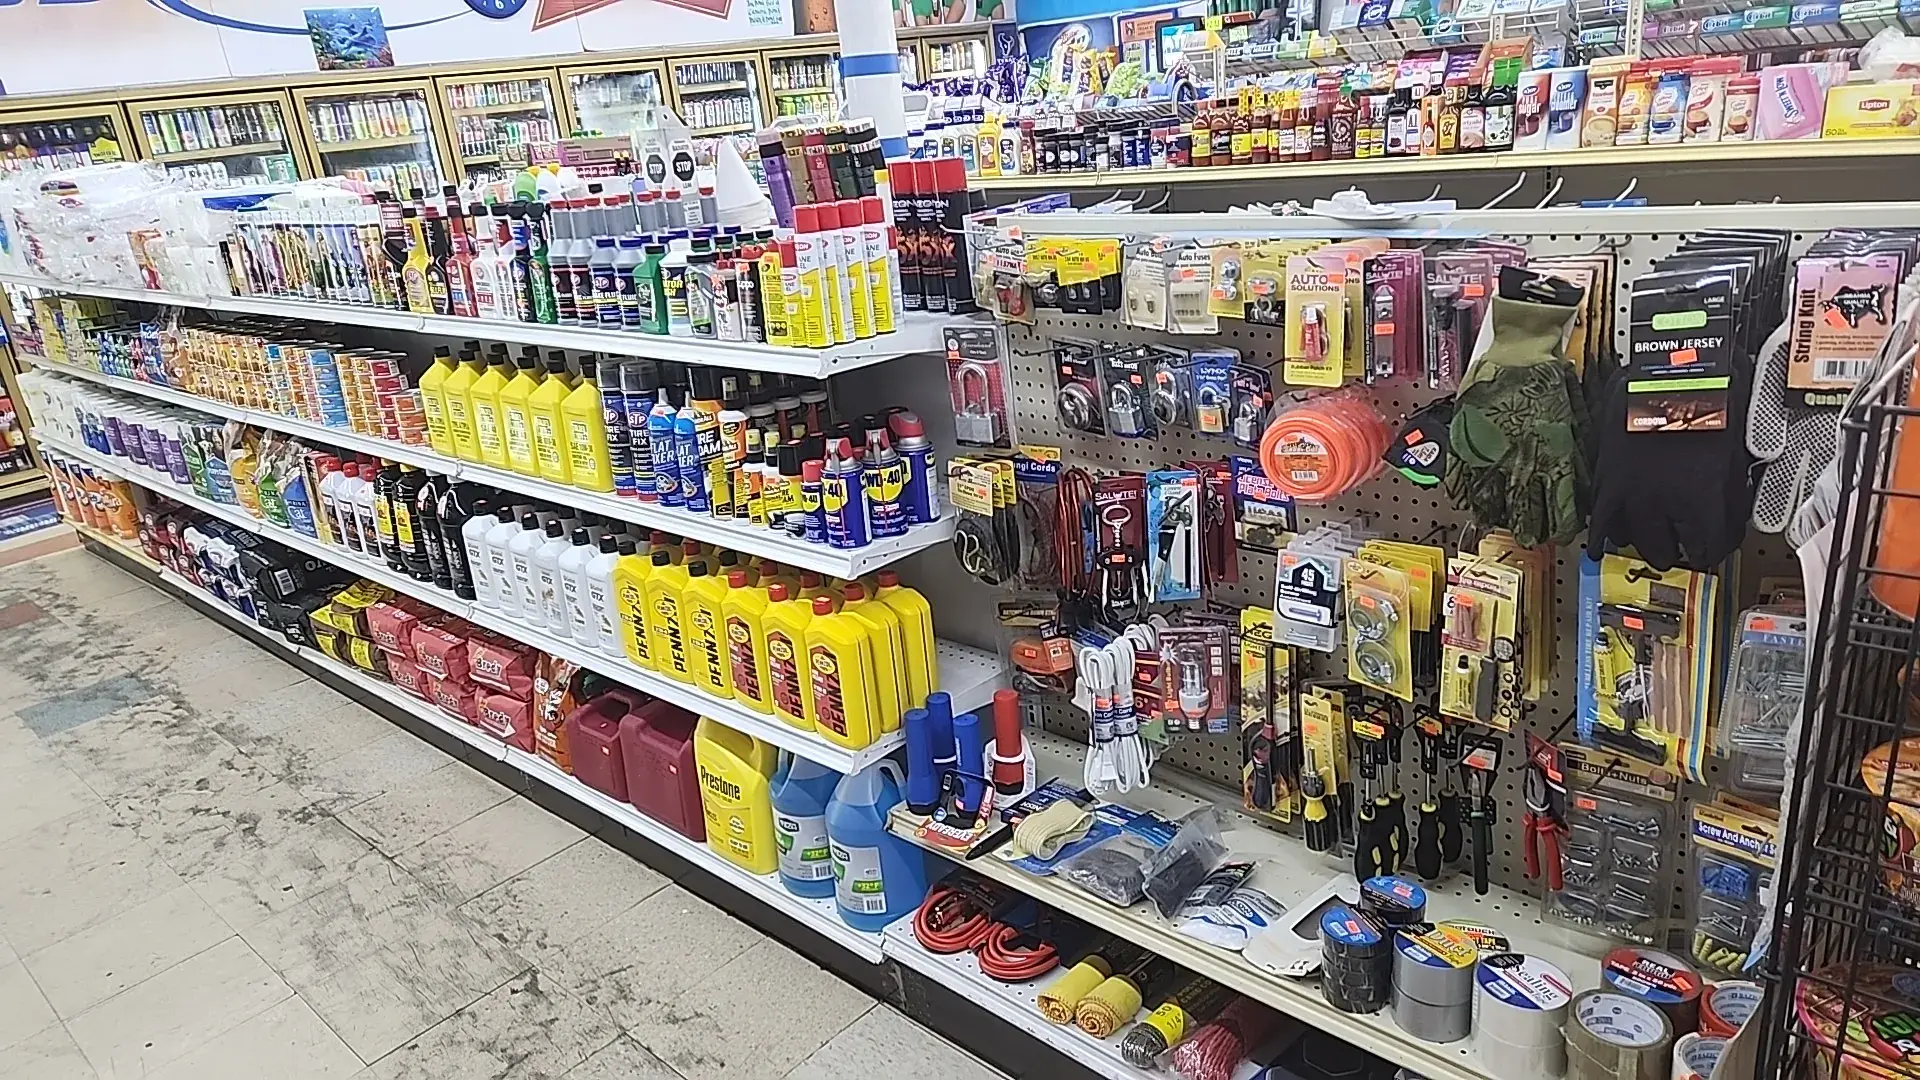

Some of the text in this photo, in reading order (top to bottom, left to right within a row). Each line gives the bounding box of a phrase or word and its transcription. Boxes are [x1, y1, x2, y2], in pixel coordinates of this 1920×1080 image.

[273, 101, 279, 112] 5
[1518, 102, 1542, 117] sugar
[1860, 100, 1888, 110] Lipton
[649, 163, 664, 174] STOP
[676, 160, 692, 173] STOP
[1179, 252, 1211, 260] Auto Fuses
[1291, 274, 1327, 284] AUTO
[1290, 284, 1339, 292] SOLUTIONS
[1703, 296, 1725, 304] LARGE
[1794, 288, 1816, 363] String Knit
[1635, 337, 1723, 353] BROWN JERSEY
[629, 412, 648, 426] STP
[629, 429, 650, 441] TIRE
[632, 437, 648, 446] FIX
[699, 440, 720, 456] OAM
[1030, 462, 1056, 473] Cords
[865, 469, 901, 487] WD-40
[1095, 488, 1137, 501] SALUTE!
[1265, 489, 1290, 502] Bolts
[469, 549, 480, 558] GTX
[492, 556, 504, 566] GTX
[515, 564, 527, 574] GTX
[1301, 568, 1315, 582] 45
[541, 575, 553, 585] GTX
[565, 583, 577, 593] GTX
[591, 591, 605, 602] GTX
[700, 765, 741, 800] Prestone
[926, 821, 973, 841] EVEREADY
[1699, 823, 1722, 839] Screw
[1722, 829, 1739, 842] And
[1739, 832, 1769, 854] Anchr
[1610, 960, 1630, 973] TAPE
[1641, 959, 1669, 975] REAL
[1509, 964, 1560, 1001] Sealing
[1157, 1005, 1172, 1018] 50
